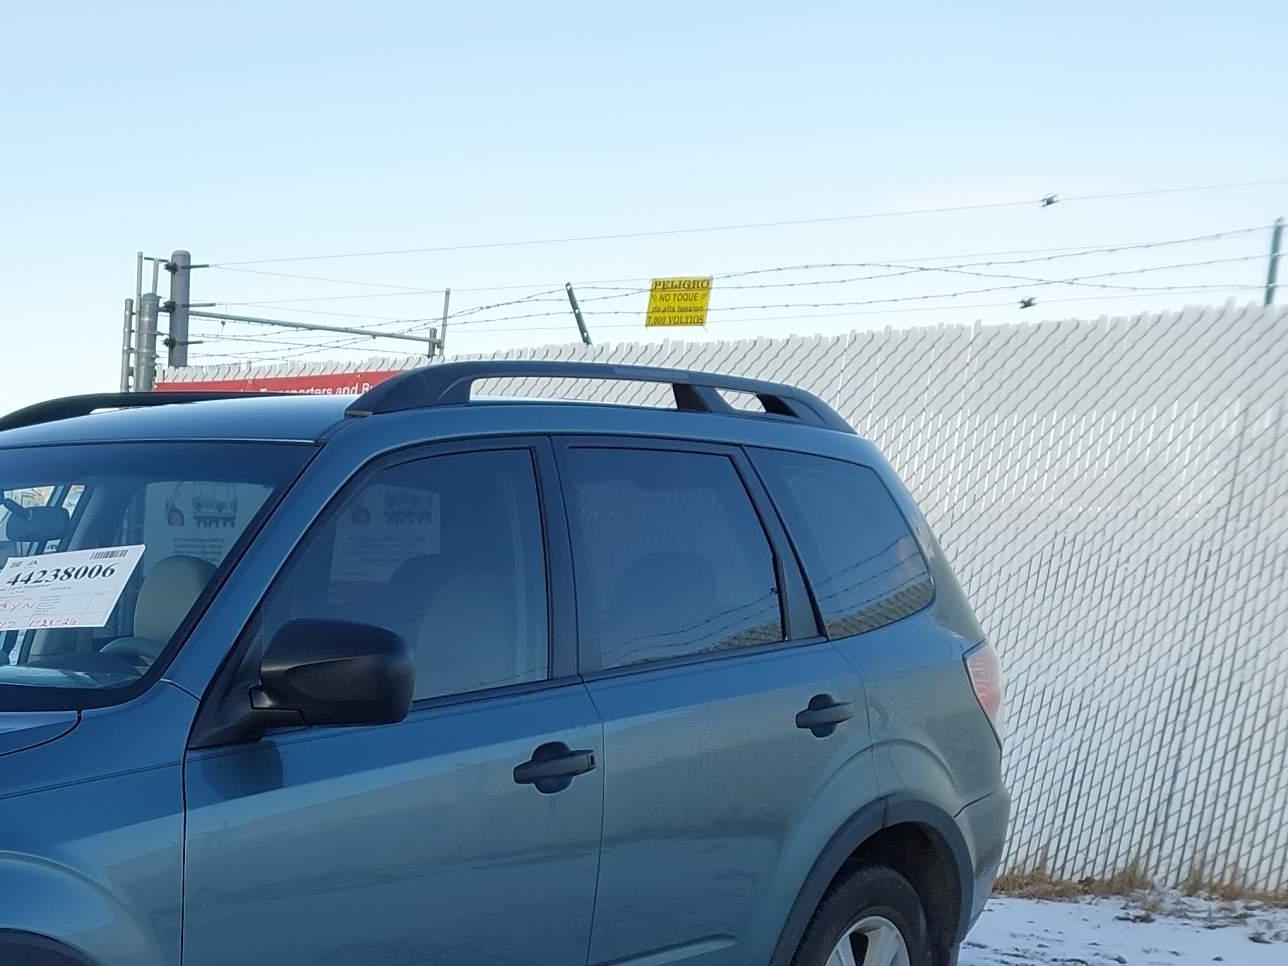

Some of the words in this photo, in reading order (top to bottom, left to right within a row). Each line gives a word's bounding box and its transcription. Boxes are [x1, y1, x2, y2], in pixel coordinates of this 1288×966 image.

[654, 279, 710, 289] PELIGRO
[659, 292, 671, 302] NO
[673, 292, 698, 302] TOQUE
[7, 562, 119, 586] 44238006
